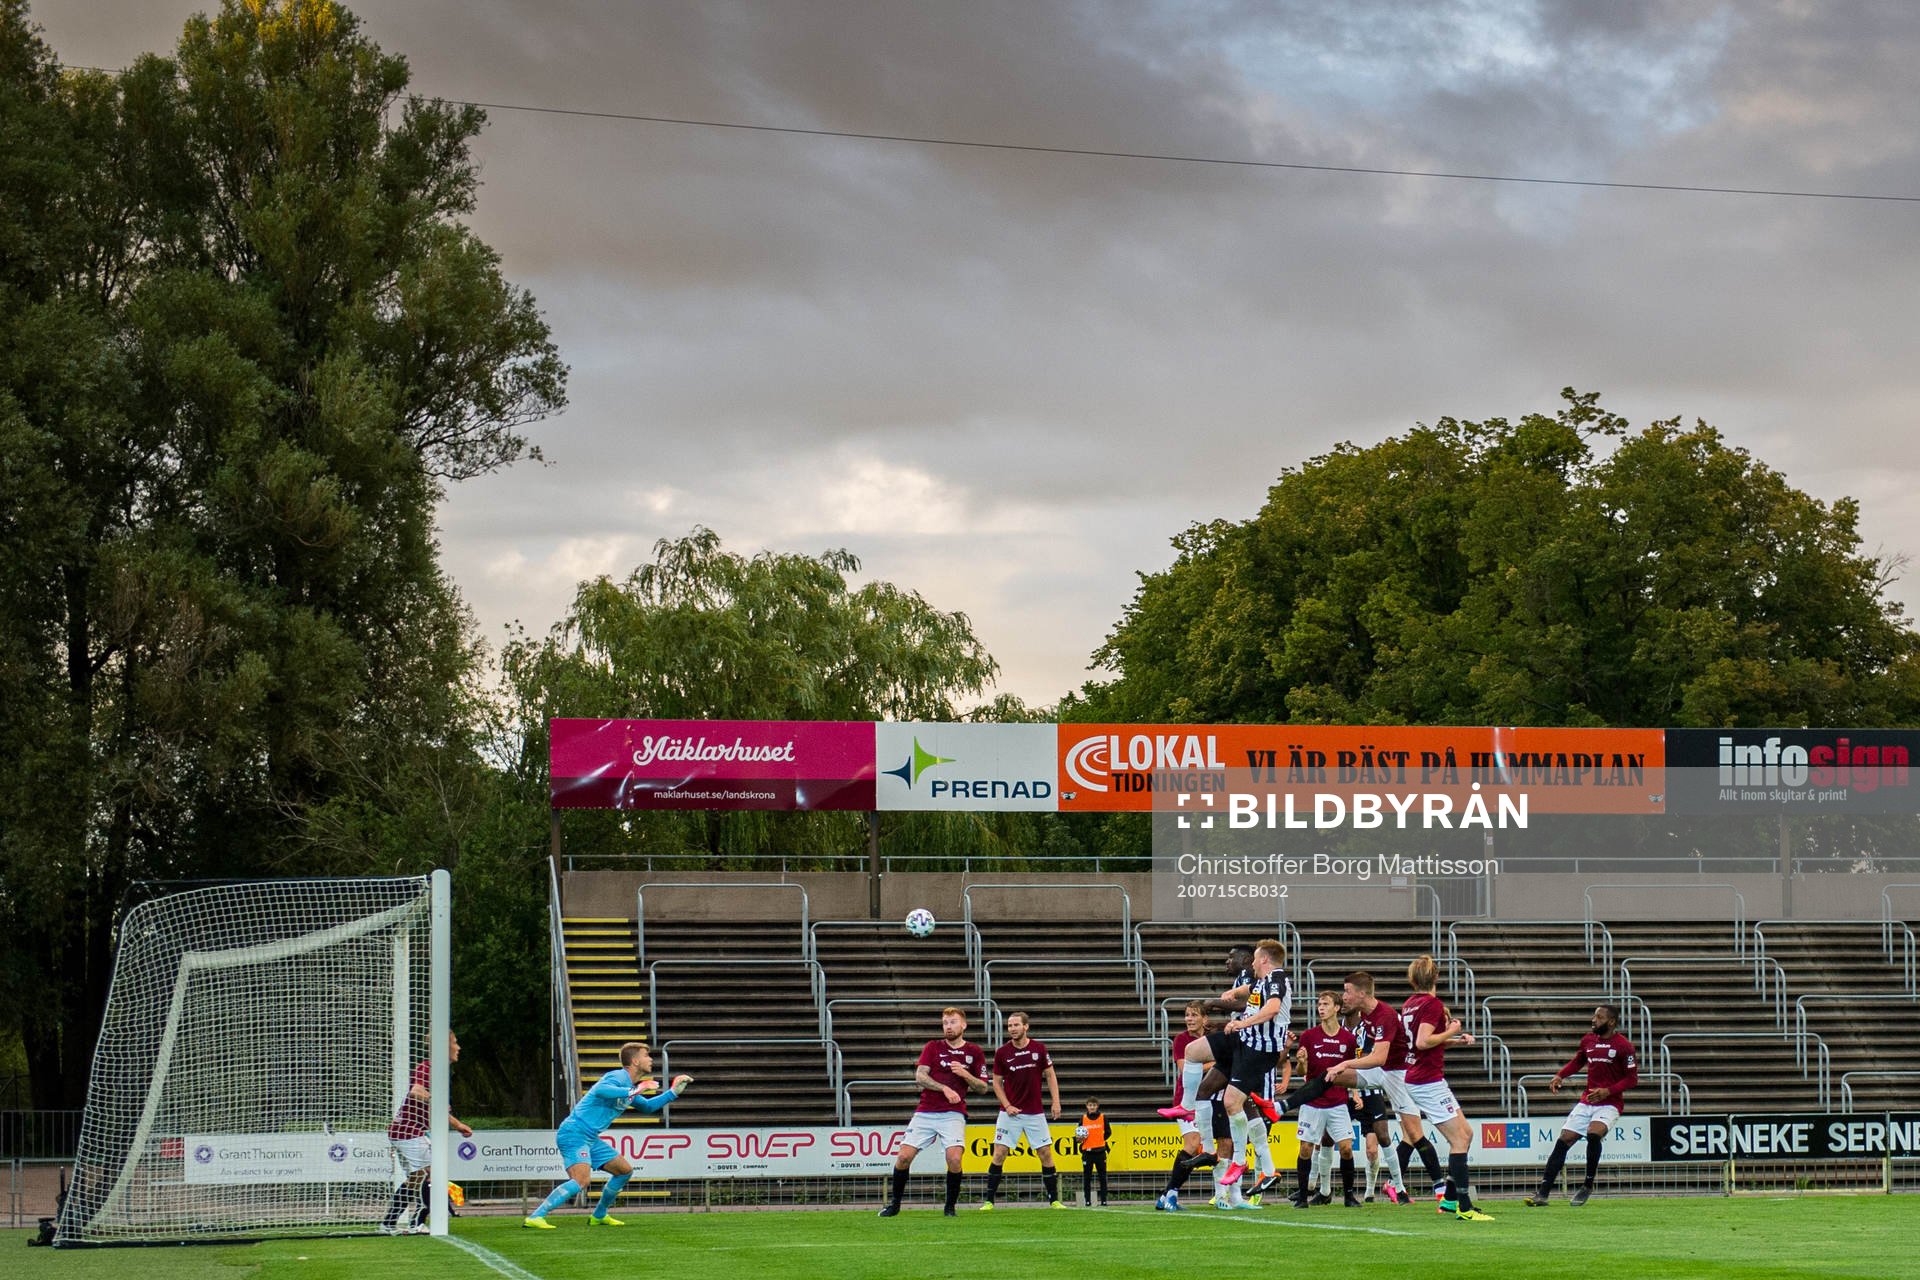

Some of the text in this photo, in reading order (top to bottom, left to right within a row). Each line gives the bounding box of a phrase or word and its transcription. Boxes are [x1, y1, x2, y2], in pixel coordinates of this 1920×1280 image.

[633, 735, 796, 767] Mäklarhuset
[1109, 734, 1226, 771] LOKAL
[1247, 744, 1646, 787] VI ÄR BÄST PÅ HEMMAPLAN
[1719, 737, 1910, 793] infosign
[931, 780, 1052, 799] PRENAD
[1112, 772, 1226, 793] TIDNINGEN
[653, 790, 776, 802] maklarhuset.se/landskrona
[1719, 788, 1847, 804] Allt inom skyltar & print!
[830, 1131, 906, 1157] SWE
[1132, 1136, 1184, 1146] KOMMUN
[1486, 1128, 1502, 1144] M
[1669, 1123, 1810, 1156] SERNEKE
[218, 1148, 251, 1160] Grant
[352, 1147, 385, 1159] Grant
[481, 1145, 512, 1157] Grant
[707, 1132, 815, 1159] SWEP
[1132, 1149, 1157, 1159] SOM
[483, 1164, 494, 1173] An
[496, 1163, 523, 1173] instinct
[525, 1163, 536, 1172] for
